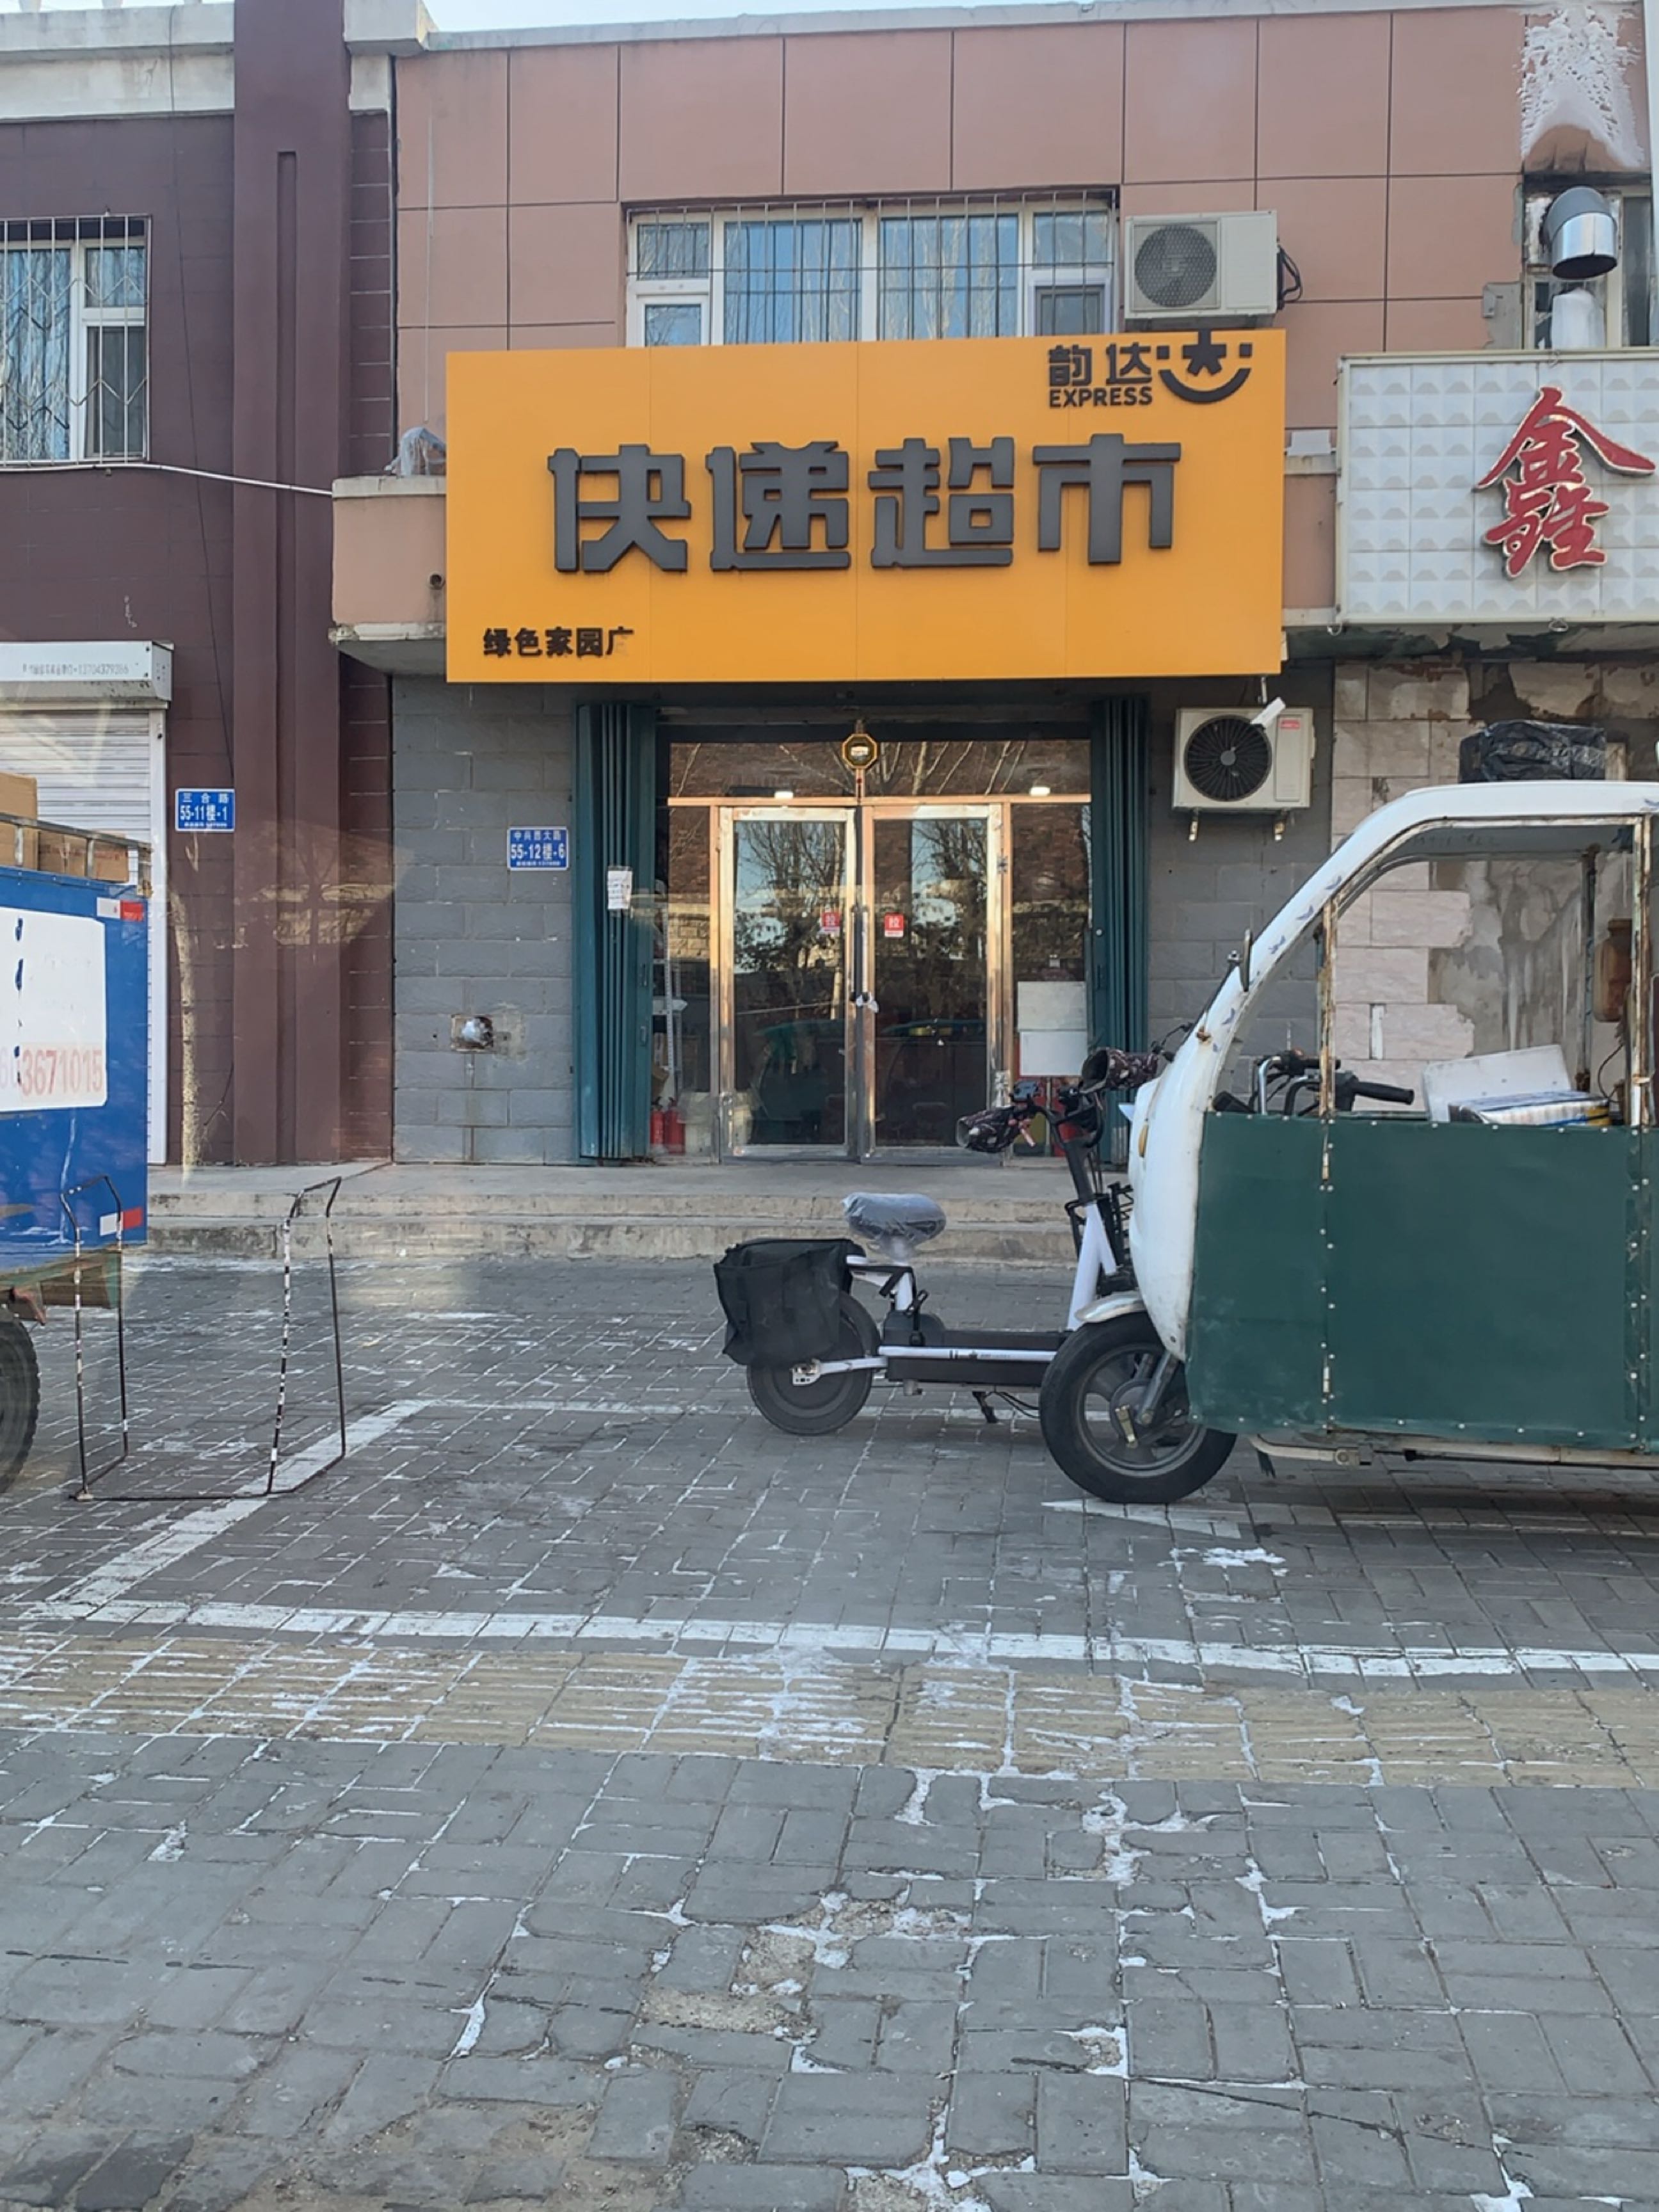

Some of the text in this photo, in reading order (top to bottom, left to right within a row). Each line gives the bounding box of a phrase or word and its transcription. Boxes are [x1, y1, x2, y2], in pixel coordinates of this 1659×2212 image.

[1047, 342, 1152, 387] 韵达
[1048, 386, 1152, 408] EXPRESS
[548, 433, 1182, 573] 快递超市
[1473, 386, 1656, 577] 鑫
[483, 626, 634, 657] 绿色家园广
